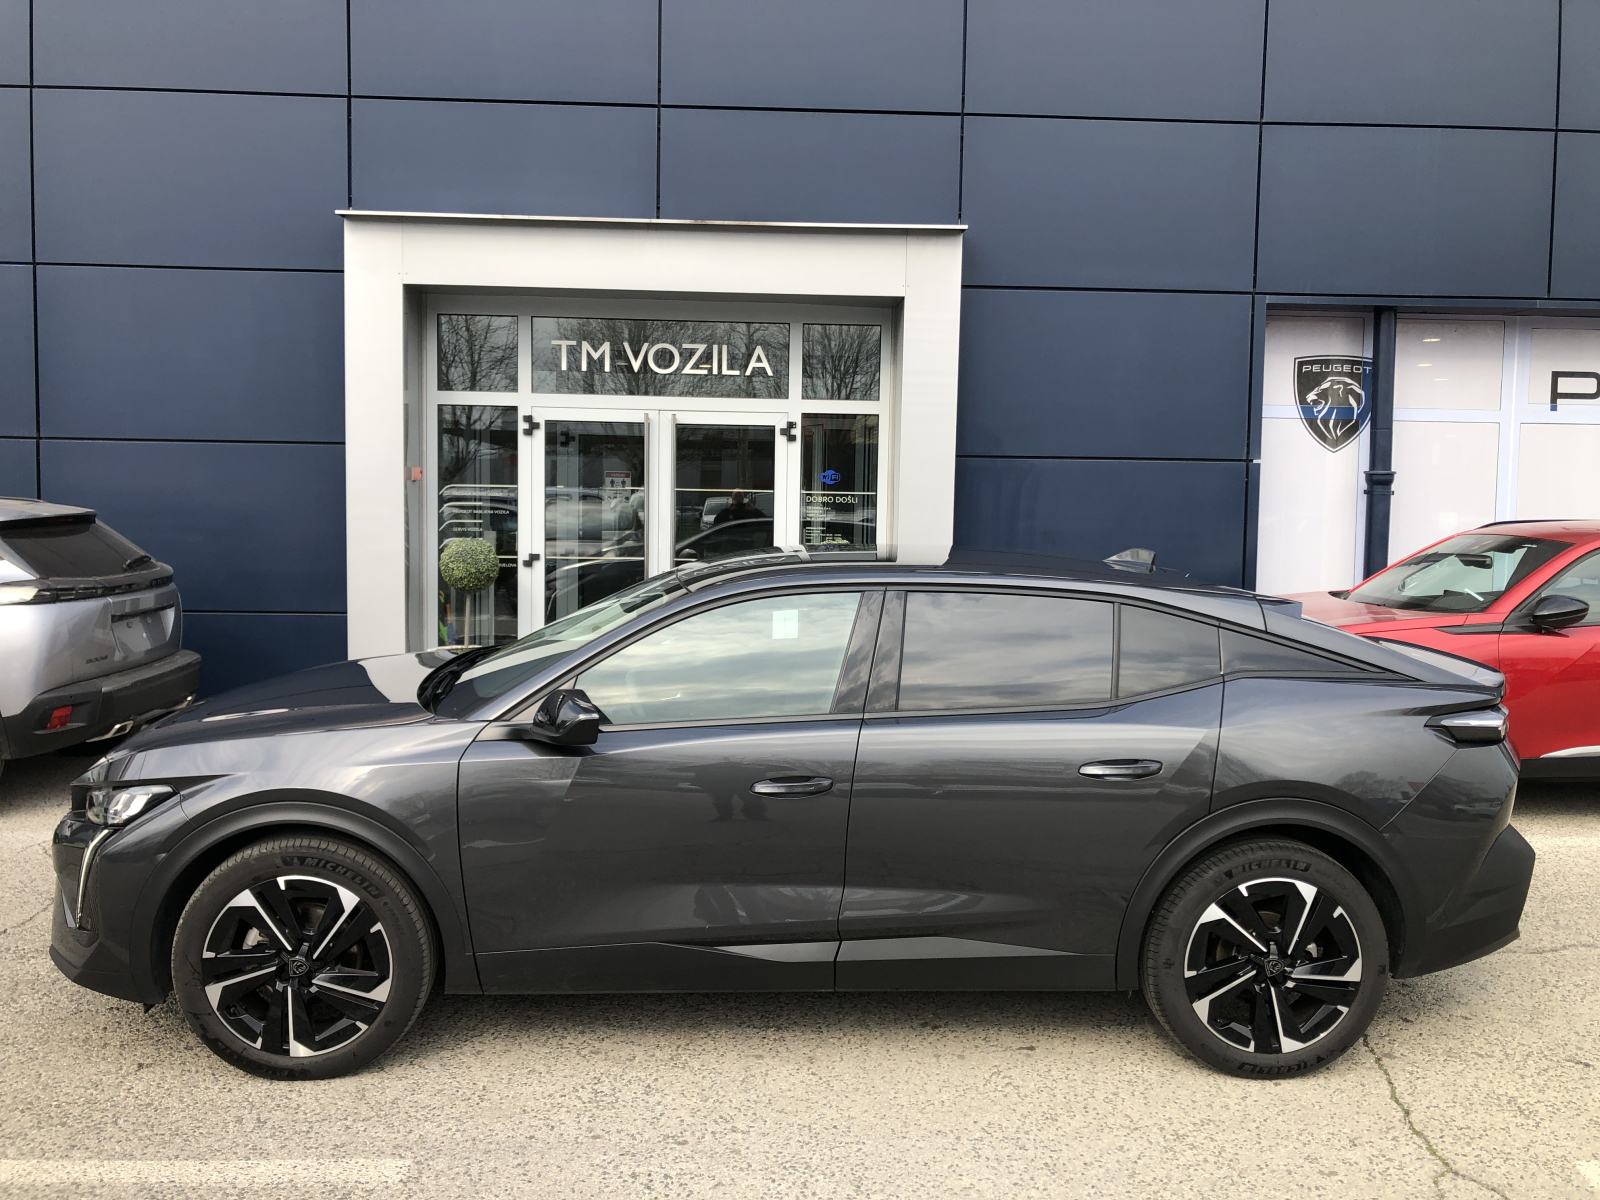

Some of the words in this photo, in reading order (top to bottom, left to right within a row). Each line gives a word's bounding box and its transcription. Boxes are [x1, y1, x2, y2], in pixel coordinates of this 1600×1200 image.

[551, 340, 611, 372] TM
[623, 342, 774, 376] VOZILA
[1302, 364, 1373, 374] PEUGEOT
[1550, 371, 1600, 411] P
[805, 495, 834, 503] DOBRO
[835, 495, 858, 504] DOŠLI
